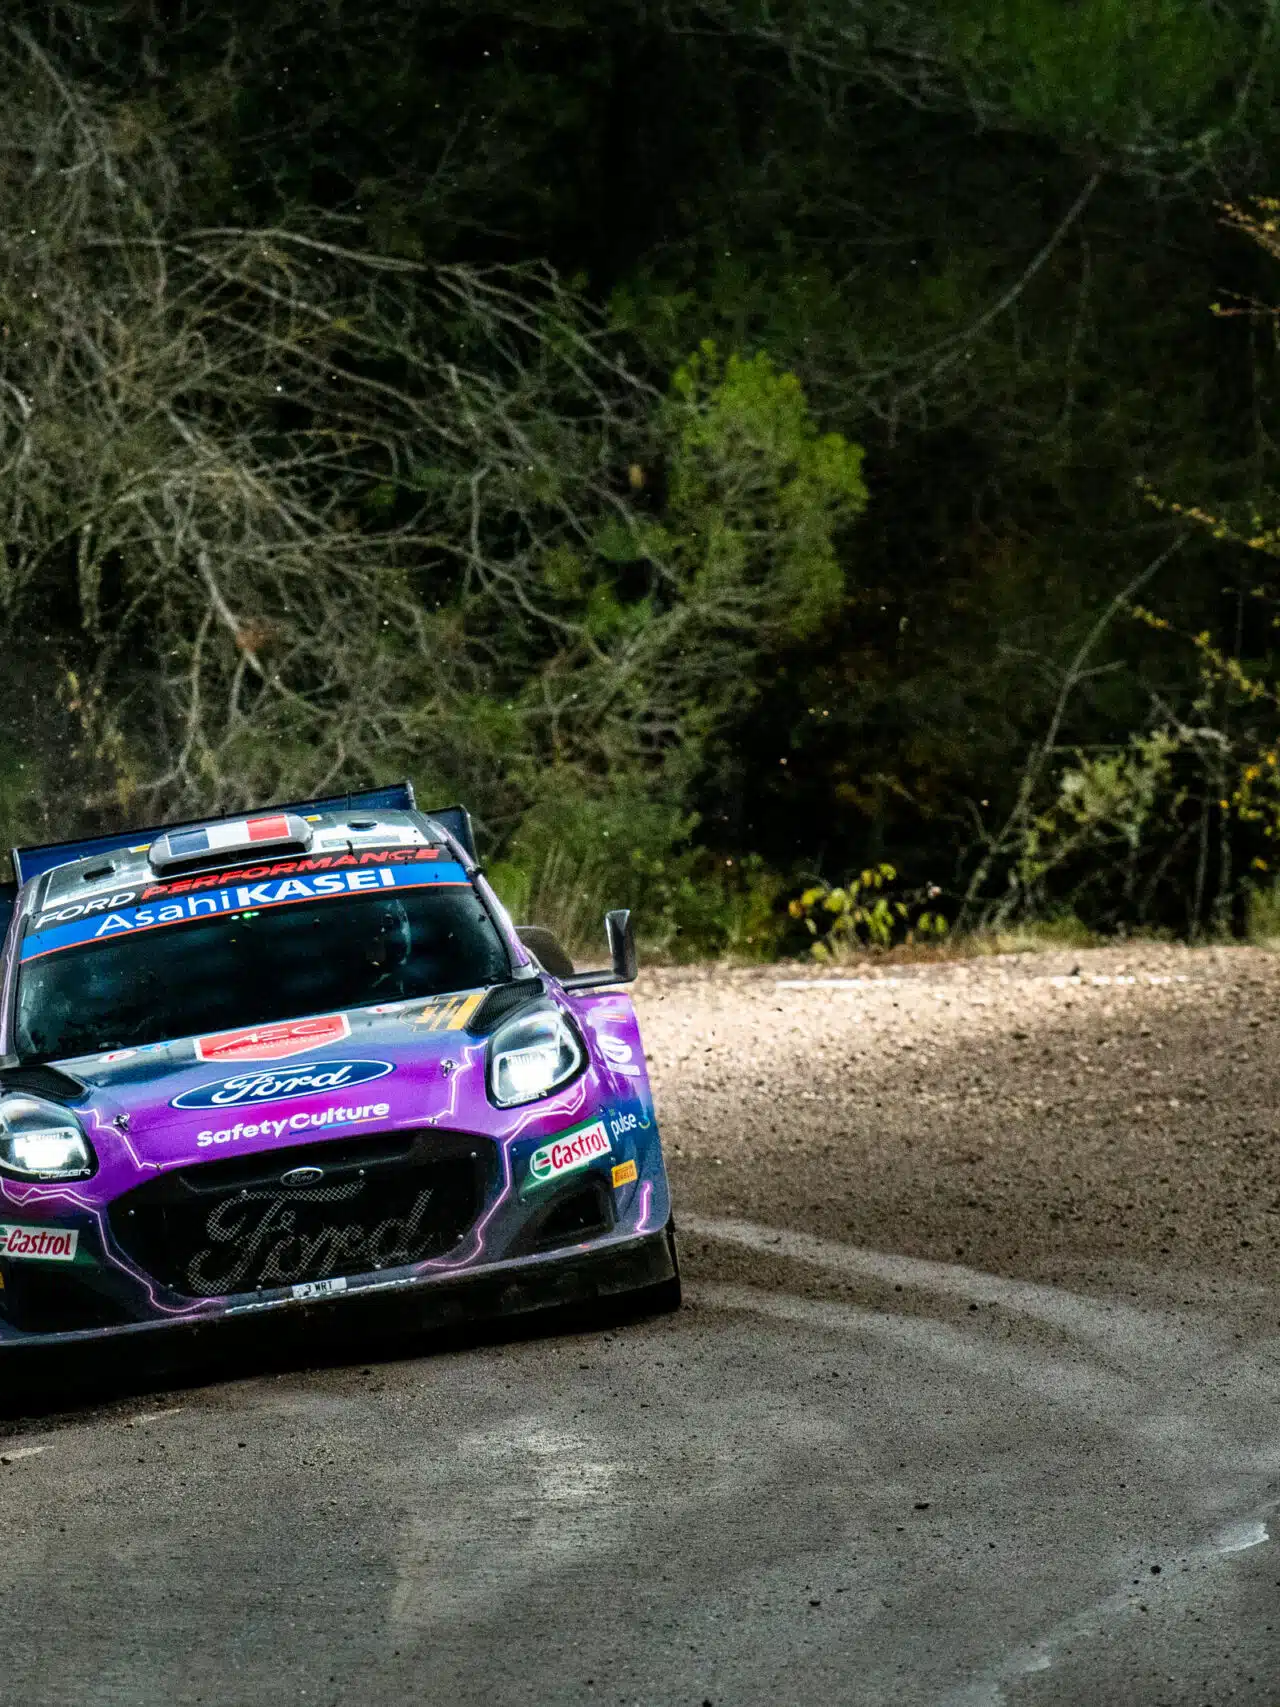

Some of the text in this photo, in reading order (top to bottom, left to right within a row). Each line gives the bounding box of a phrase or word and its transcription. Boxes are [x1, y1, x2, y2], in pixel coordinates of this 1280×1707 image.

[34, 848, 440, 929] FORD PERFORMANCE
[95, 868, 396, 937] Asahi KASEI
[211, 1064, 354, 1104] Ford
[196, 1102, 390, 1147] SafetyCulture
[611, 1113, 637, 1142] pulse
[551, 1127, 608, 1170] Castrol
[7, 1229, 71, 1257] Castrol
[187, 1180, 434, 1296] Ford
[314, 1280, 333, 1291] WRT
